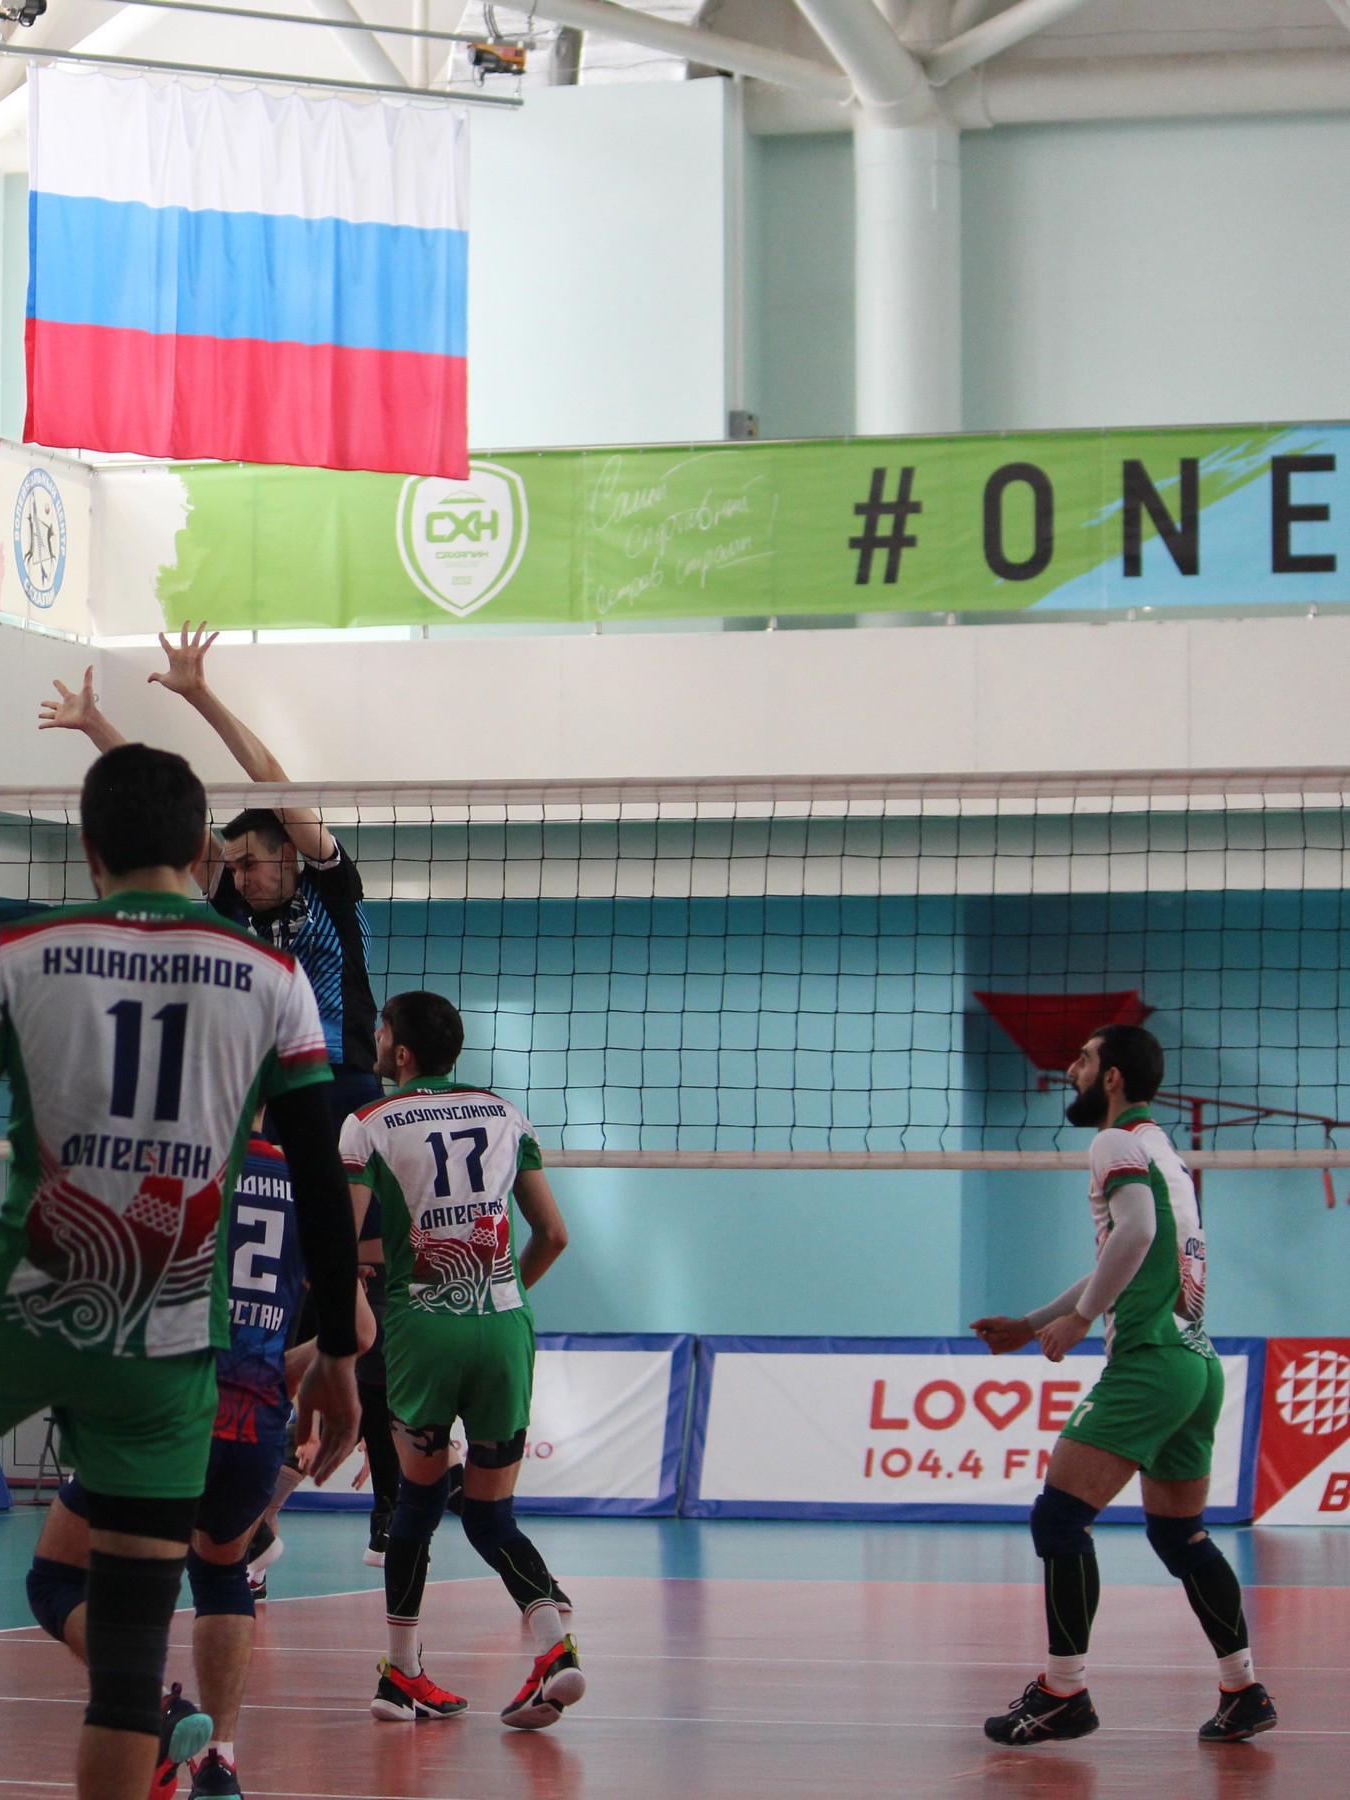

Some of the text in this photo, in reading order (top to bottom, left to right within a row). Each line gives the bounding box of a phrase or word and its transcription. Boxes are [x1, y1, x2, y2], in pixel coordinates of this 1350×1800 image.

[42, 947, 254, 993] НУЦАЛХАНОВ
[106, 999, 188, 1122] 11
[384, 1105, 507, 1129] АБДУЛМУСЛИМОВ
[61, 1134, 212, 1180] ДАГЕСТАН
[425, 1127, 489, 1198] 17
[420, 1198, 504, 1231] ДАГЕСТАН
[232, 1205, 285, 1293] 2
[864, 1447, 984, 1480] 104.4
